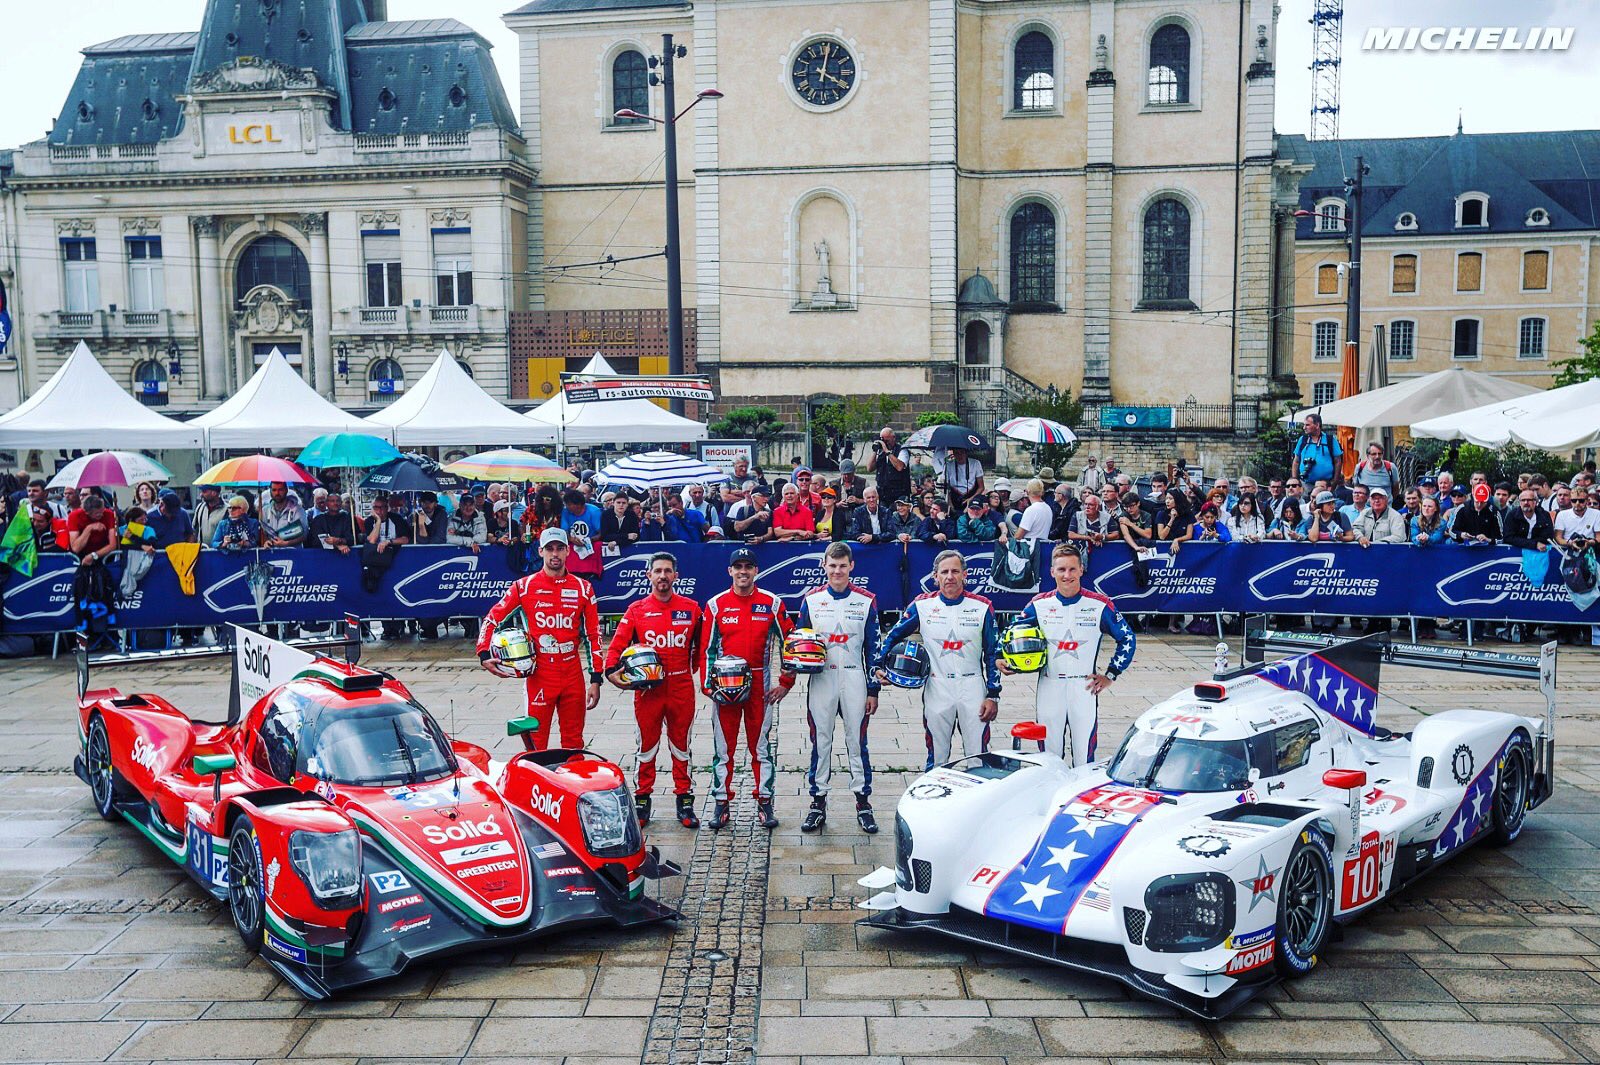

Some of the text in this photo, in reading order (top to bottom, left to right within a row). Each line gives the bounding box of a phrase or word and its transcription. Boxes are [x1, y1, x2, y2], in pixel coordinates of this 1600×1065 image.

[229, 125, 282, 144] LCL
[605, 388, 709, 399] rs-automobiles.com
[574, 523, 587, 535] 20
[441, 571, 488, 580] CIRCUIT
[619, 569, 647, 578] CIRC
[793, 568, 827, 576] CIRCU
[966, 568, 991, 576] CIRC
[1149, 569, 1186, 577] IRCUIT
[1296, 568, 1345, 577] CIRCUIT
[1488, 573, 1529, 581] CIRCU
[269, 575, 303, 585] RCUIT
[456, 581, 471, 589] 24
[472, 580, 518, 589] HEURE
[806, 577, 821, 585] 24
[1153, 577, 1217, 586] 24 HEURES
[1311, 578, 1327, 586] 24
[1328, 578, 1379, 587] HEURES
[269, 584, 338, 594] 24 HEURES
[1159, 586, 1215, 594] DU MANS
[1316, 587, 1377, 596] DU MANS
[1504, 583, 1521, 591] 24
[1522, 584, 1567, 592] HEURE
[276, 593, 337, 603] DU MANS
[461, 589, 510, 598] DU MAN
[1510, 592, 1529, 600] DU
[113, 600, 141, 609] ANS
[828, 633, 849, 644] 10
[943, 639, 963, 650] 10
[1057, 641, 1079, 651] 10
[1397, 644, 1438, 652] SHANGHAI
[1090, 791, 1145, 809] 10
[1361, 837, 1379, 851] TOTAL
[193, 828, 209, 875] 31
[1384, 837, 1394, 863] P1
[215, 858, 229, 883] P2
[457, 859, 518, 879] GREENTECH
[547, 867, 582, 877] MOTUL
[374, 873, 406, 890] P2
[972, 868, 999, 885] P1
[1349, 855, 1375, 904] 10
[1253, 874, 1274, 895] 10
[381, 895, 422, 913] MOTUL
[1242, 929, 1272, 945] MICHELIN
[272, 941, 299, 958] MICHELIN
[1229, 944, 1273, 972] MOTUL
